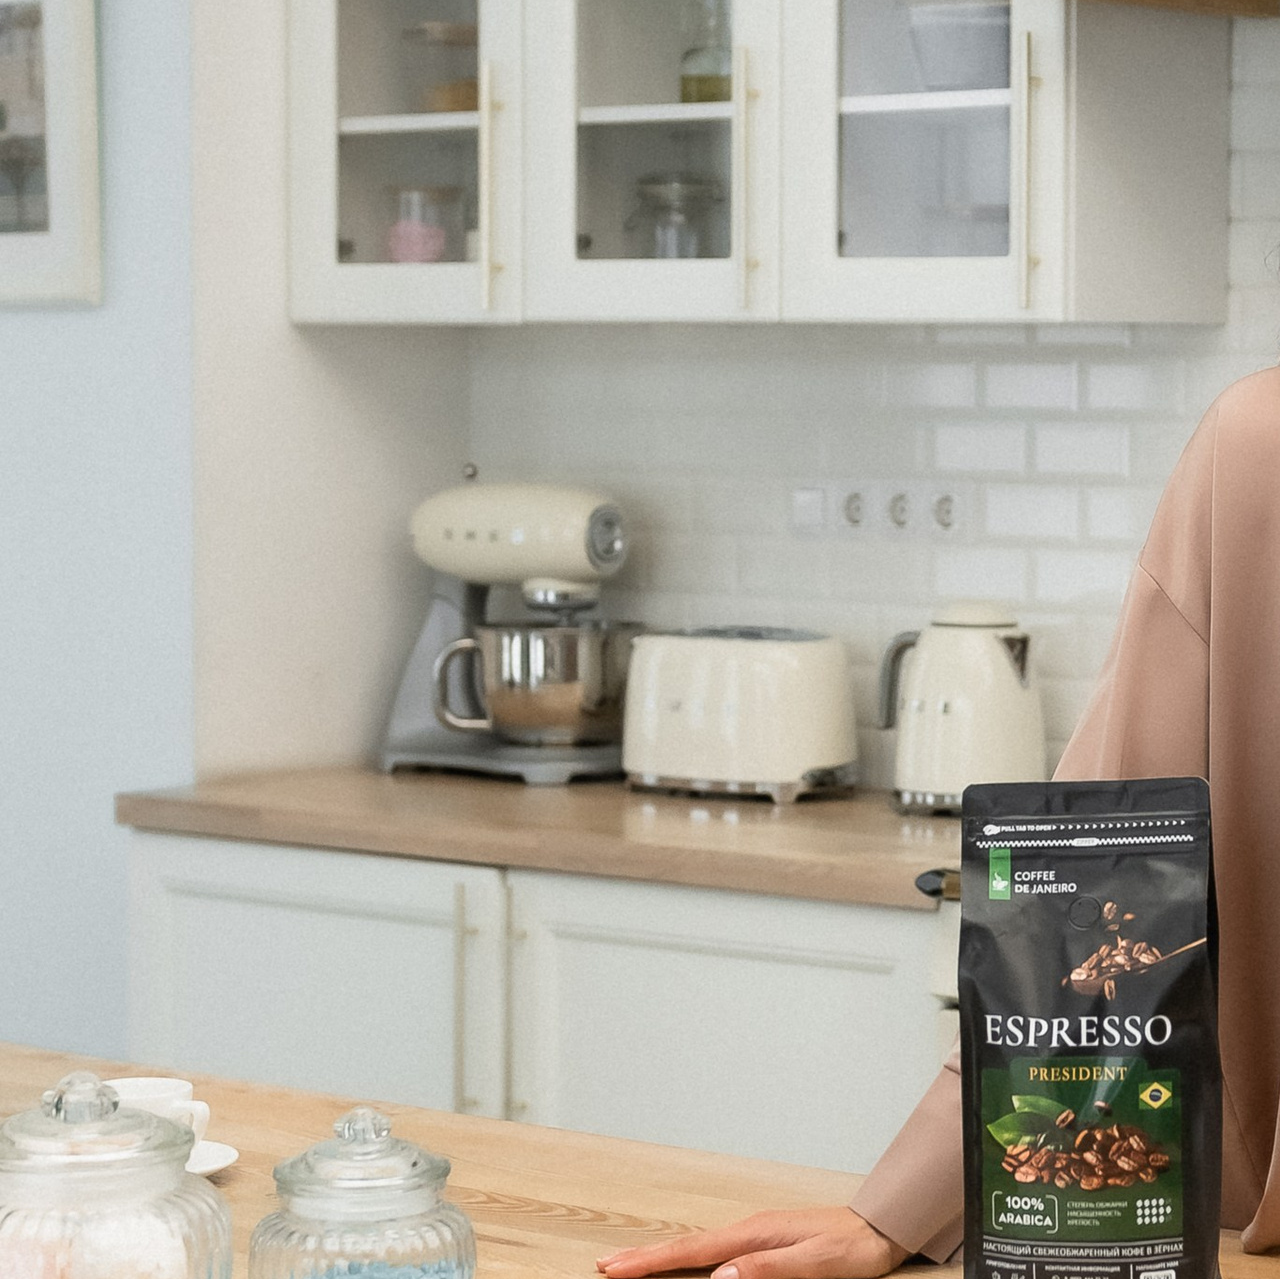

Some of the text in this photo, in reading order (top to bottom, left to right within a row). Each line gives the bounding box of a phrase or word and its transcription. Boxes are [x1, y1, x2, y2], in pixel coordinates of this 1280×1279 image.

[1014, 871, 1056, 881] COFFEE
[1014, 883, 1077, 894] DE JANEIRO
[984, 1014, 1172, 1047] ESPRESSO
[1029, 1066, 1128, 1081] PRESIDENT
[1005, 1195, 1045, 1211] 100%
[998, 1212, 1053, 1227] ARABICA
[983, 1241, 1183, 1257] НАСТОЯЩИЙ СВЕЖЕОБЖАРЕННЫЙ КОФЕ В ЗЕРНАХ
